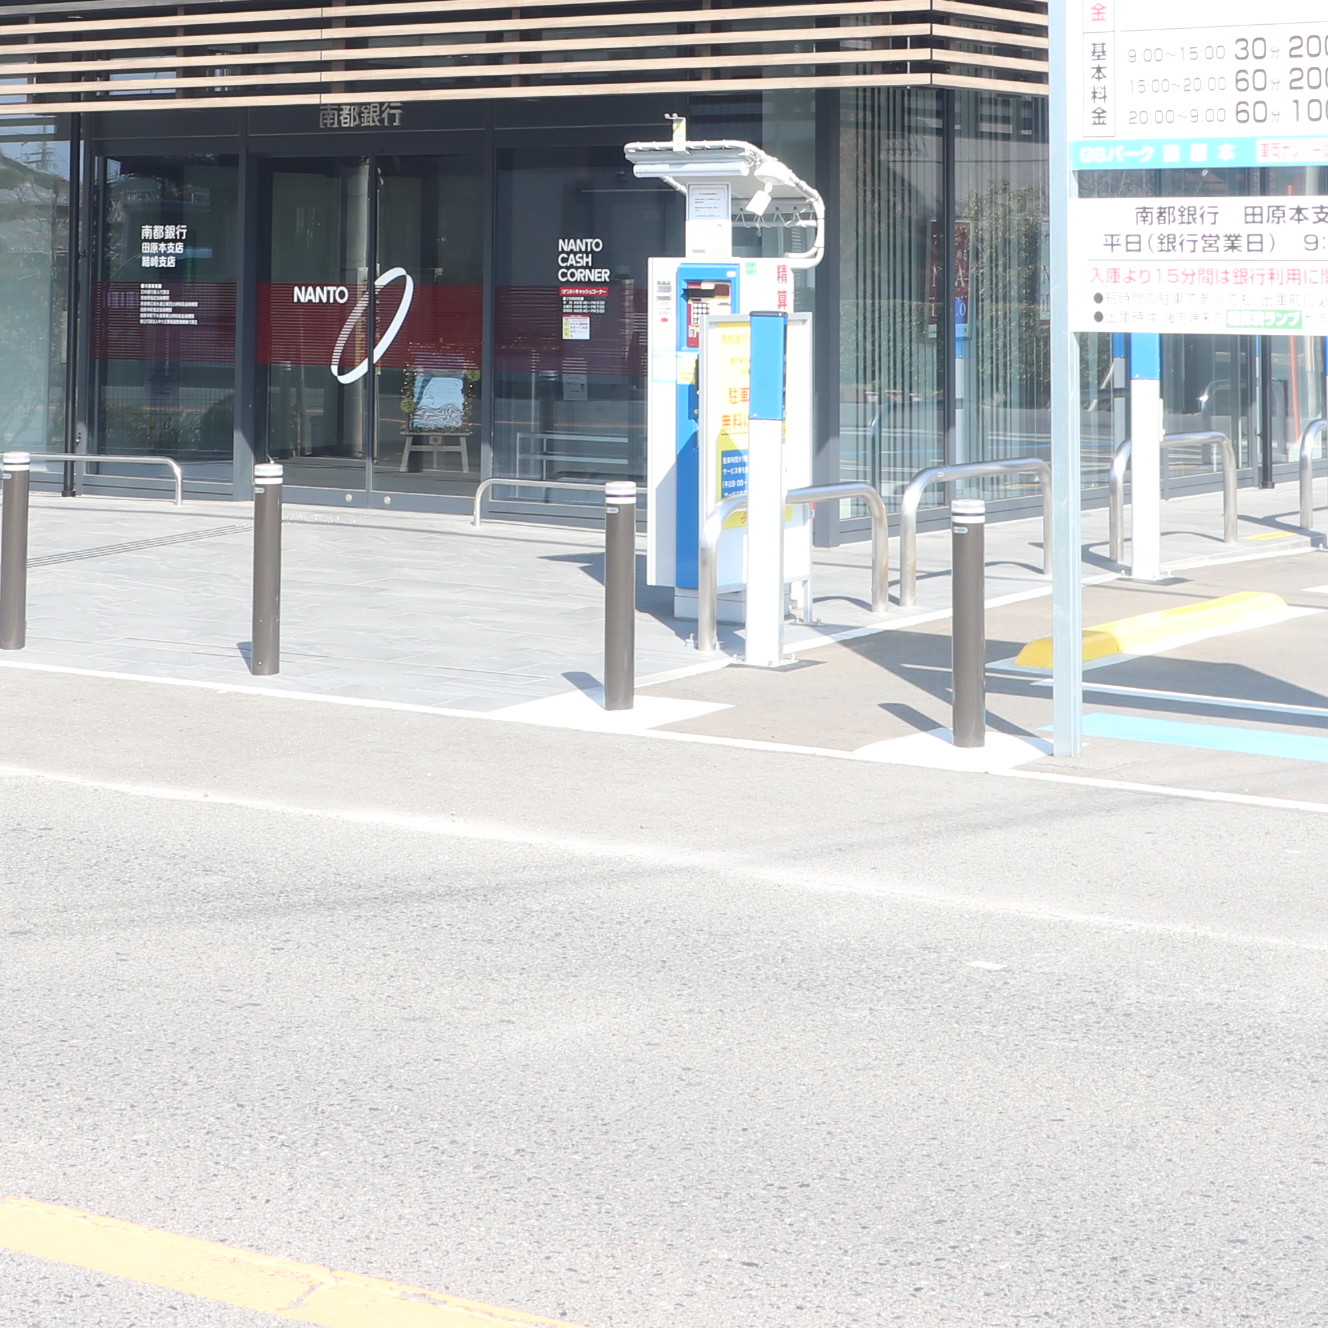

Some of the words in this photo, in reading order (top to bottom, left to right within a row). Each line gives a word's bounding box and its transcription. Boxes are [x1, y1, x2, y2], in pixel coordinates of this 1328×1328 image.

[1090, 42, 1108, 126] 基本料金
[319, 102, 404, 129] 南都銀行
[1079, 144, 1154, 163] GSパーク
[1135, 205, 1219, 225] 南都銀行
[141, 224, 187, 240] 南都銀行
[141, 242, 184, 254] 田原本支店
[558, 238, 603, 252] NANTO
[558, 253, 592, 267] CASH
[557, 268, 610, 283] CORNER
[293, 285, 349, 304] NANTO
[776, 264, 789, 310] 精算
